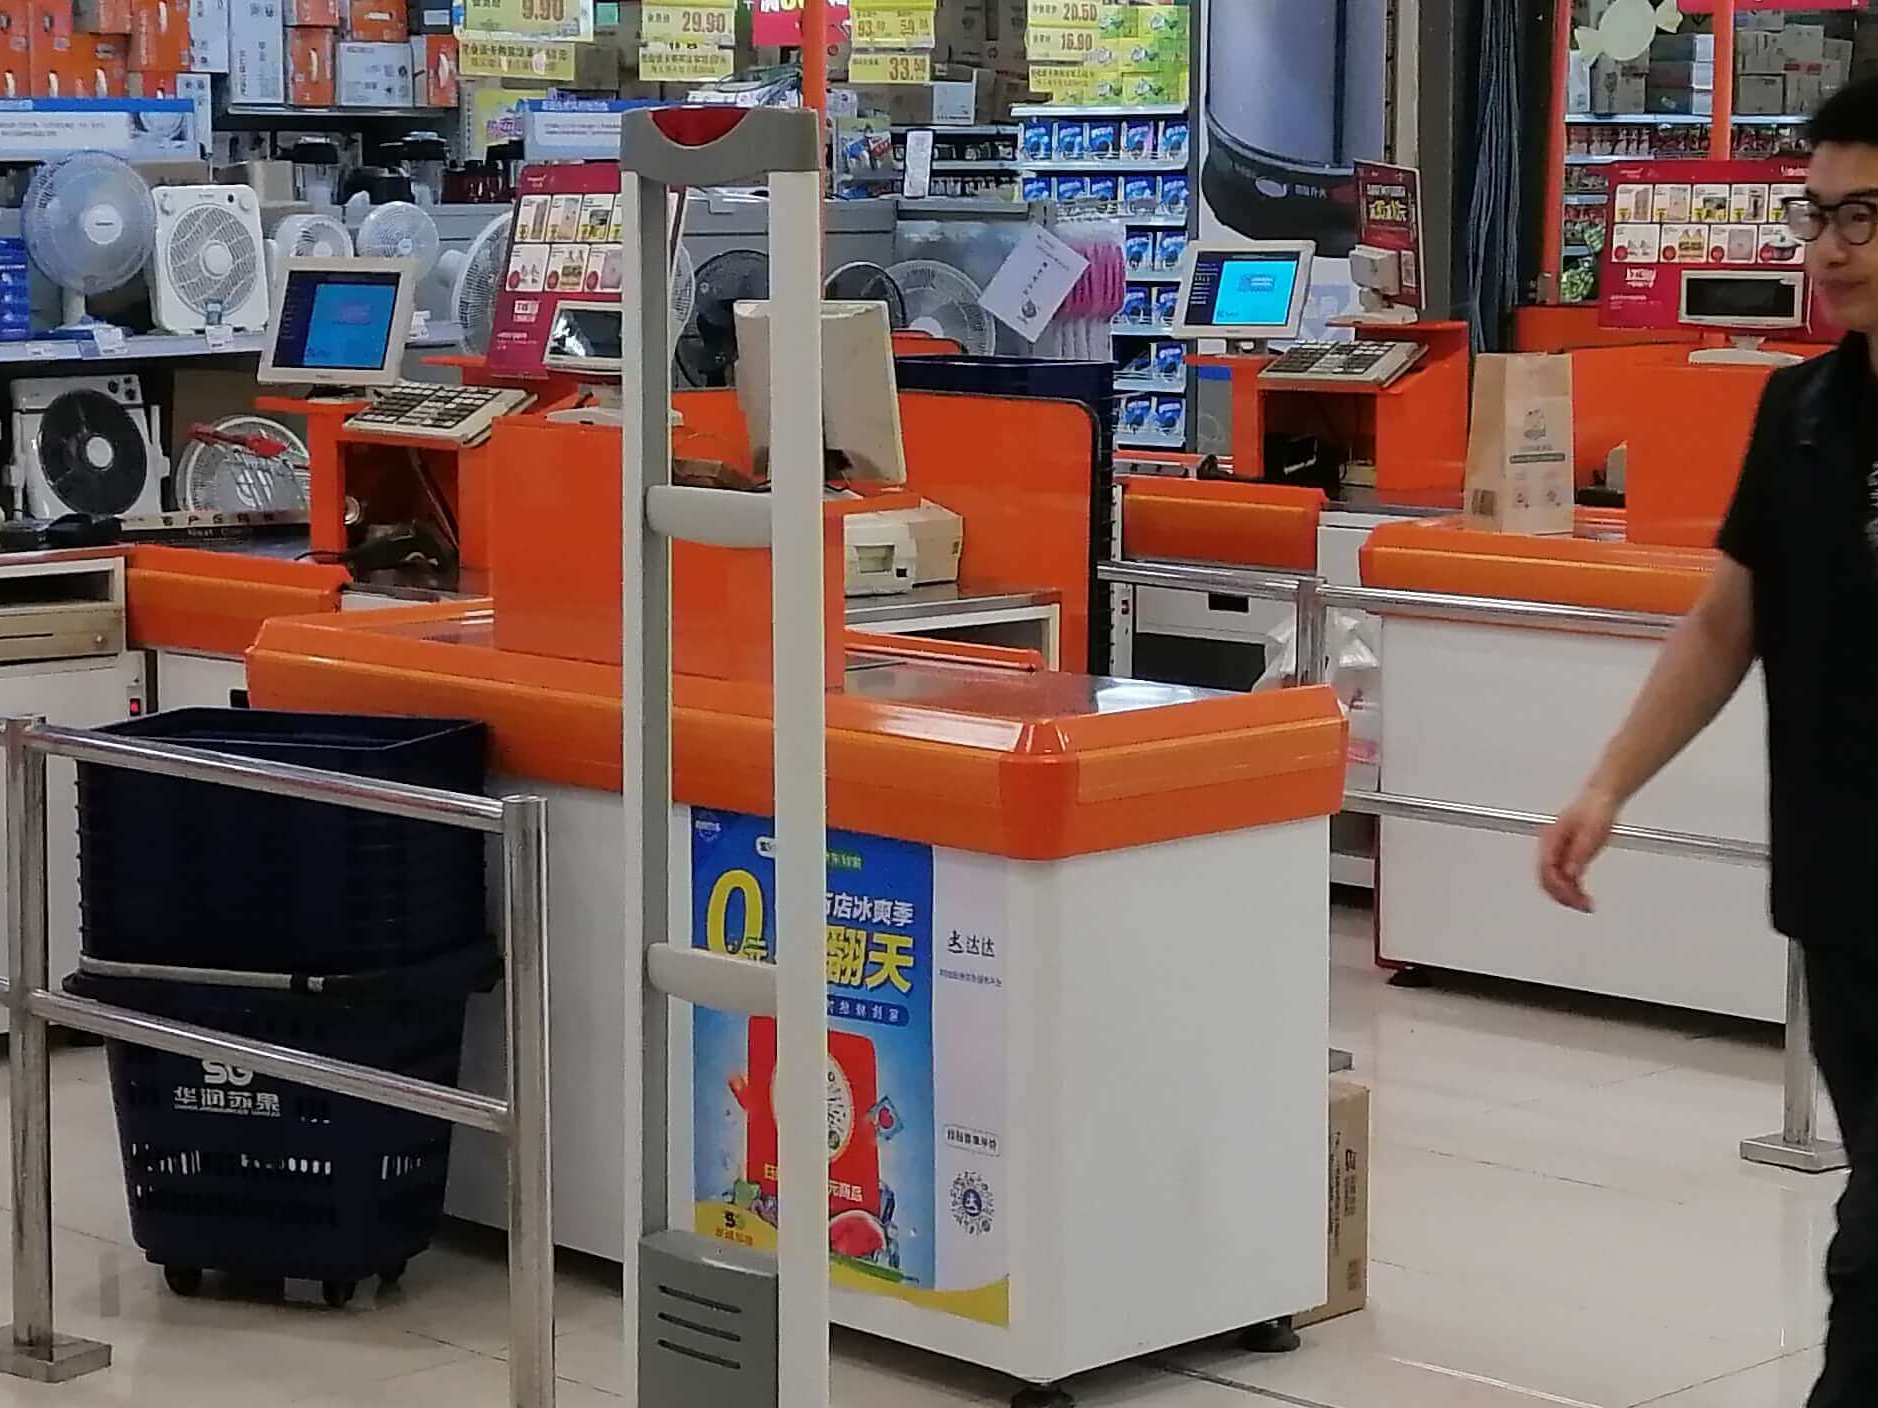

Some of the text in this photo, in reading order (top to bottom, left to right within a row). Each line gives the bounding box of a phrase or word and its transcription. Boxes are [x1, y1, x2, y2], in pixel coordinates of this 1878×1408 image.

[682, 11, 728, 33] 29.90
[174, 1085, 281, 1112] 华润苏果
